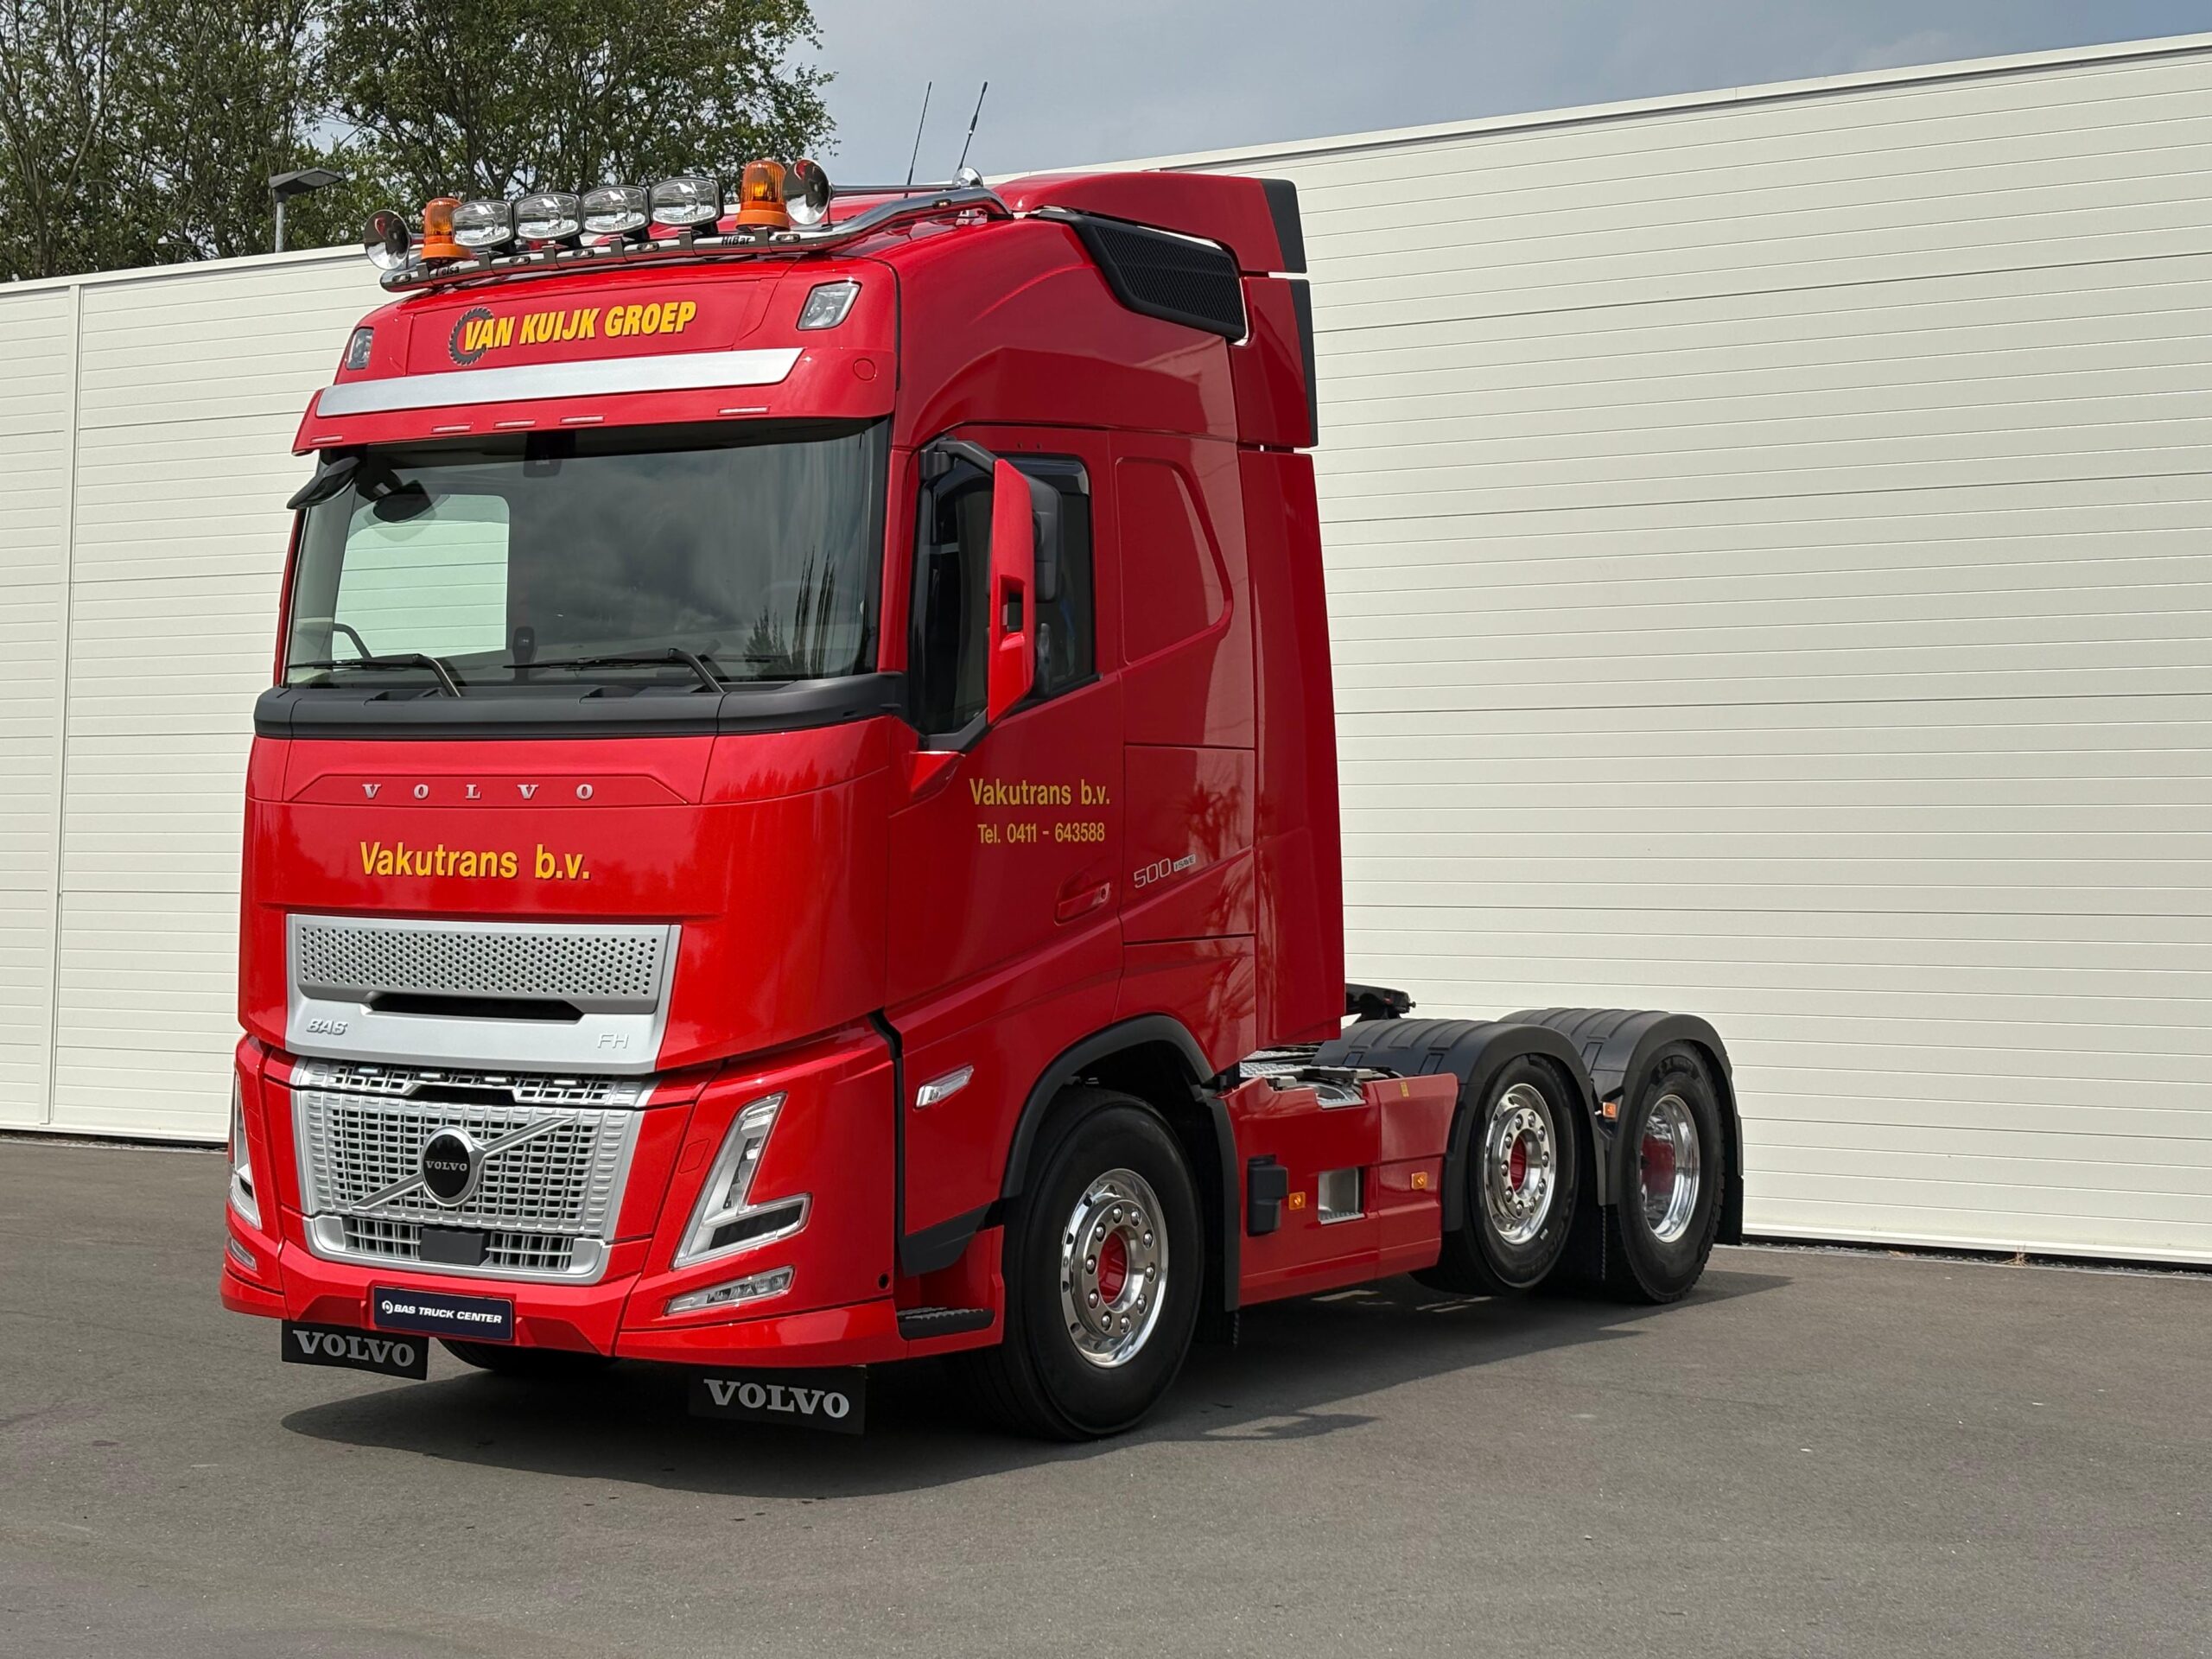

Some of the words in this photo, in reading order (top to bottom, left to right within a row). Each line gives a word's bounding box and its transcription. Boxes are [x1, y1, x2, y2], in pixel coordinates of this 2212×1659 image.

[721, 235, 752, 245] HiBar
[463, 315, 517, 353] VAN
[518, 308, 601, 345] KUIJK
[604, 301, 697, 338] GROEP
[362, 783, 594, 800] VOLVO
[969, 778, 1072, 805] Vakutrans
[1080, 779, 1110, 805] b.v.
[977, 823, 1001, 844] Tel.
[1007, 823, 1037, 844] 0411
[1054, 822, 1105, 843] 643588
[359, 841, 519, 879] Vakutrans
[534, 843, 591, 880] b.v.
[1133, 857, 1172, 889] 500
[306, 1019, 348, 1036] BAS
[597, 1033, 630, 1049] FH
[425, 1160, 467, 1172] VOLVO
[393, 1304, 416, 1314] BAS
[418, 1306, 456, 1319] TRUCK
[456, 1311, 503, 1324] CENTER
[292, 1329, 415, 1367] VOLVO
[703, 1378, 849, 1418] VOLVO
